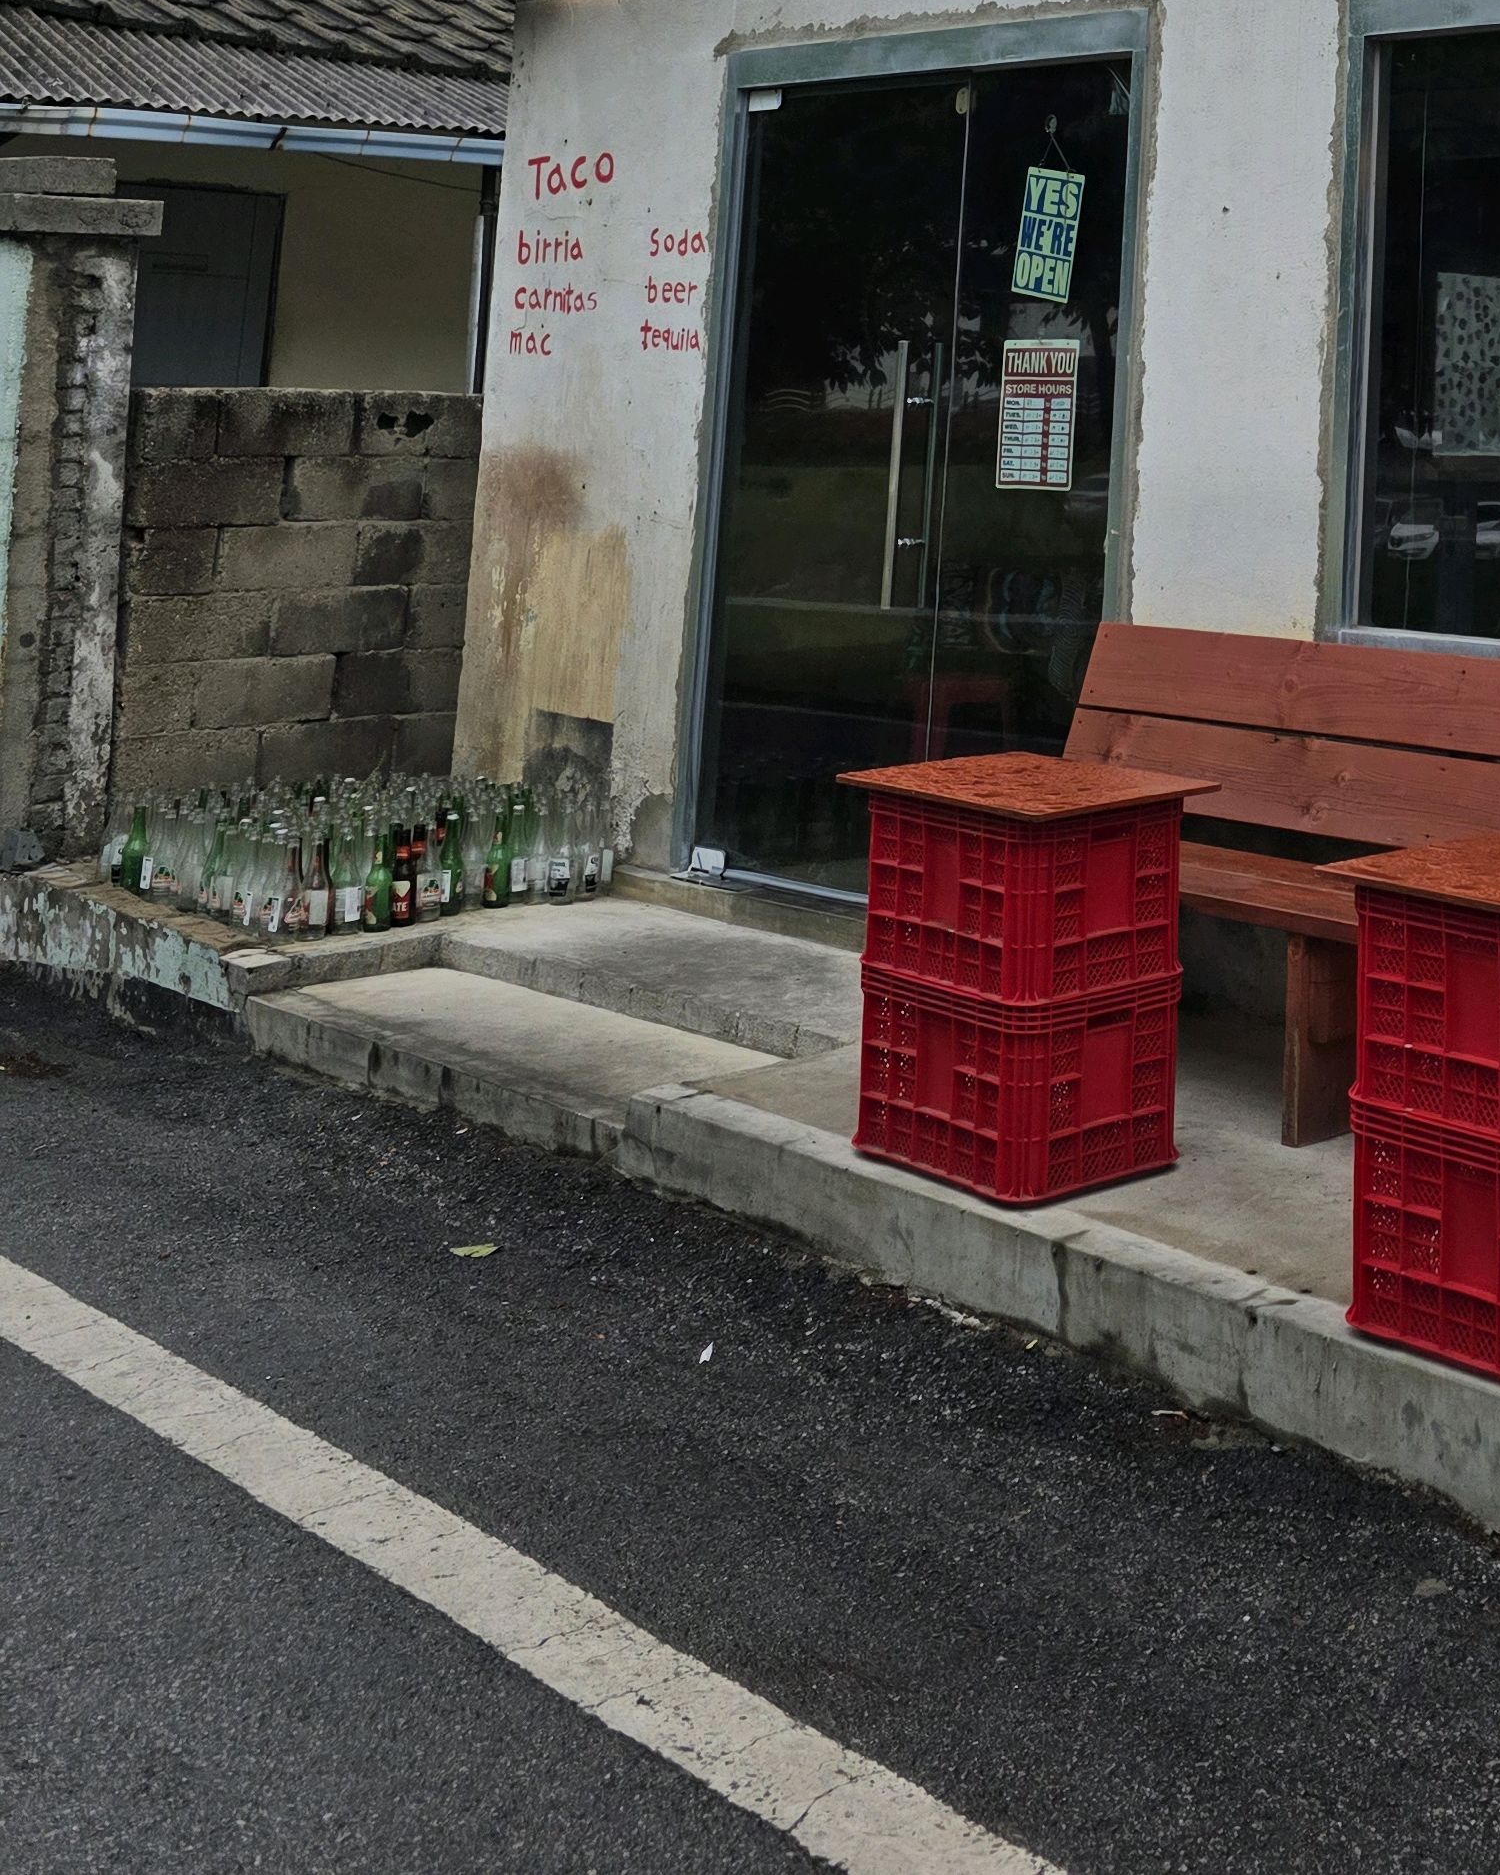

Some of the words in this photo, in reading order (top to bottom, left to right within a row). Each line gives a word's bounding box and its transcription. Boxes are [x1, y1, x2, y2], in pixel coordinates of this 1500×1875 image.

[528, 152, 614, 200] Taco
[1029, 176, 1079, 218] YES
[517, 230, 583, 265] birria
[1020, 215, 1076, 257] WE'RE
[1015, 252, 1070, 296] OPEN
[514, 282, 598, 315] carnitas
[647, 276, 698, 306] beer
[510, 330, 551, 356] mac
[640, 319, 700, 352] tequila
[1007, 351, 1048, 374] THANK
[1050, 351, 1075, 374] YOU
[1005, 383, 1037, 394] STORE
[1038, 384, 1073, 395] HOURS
